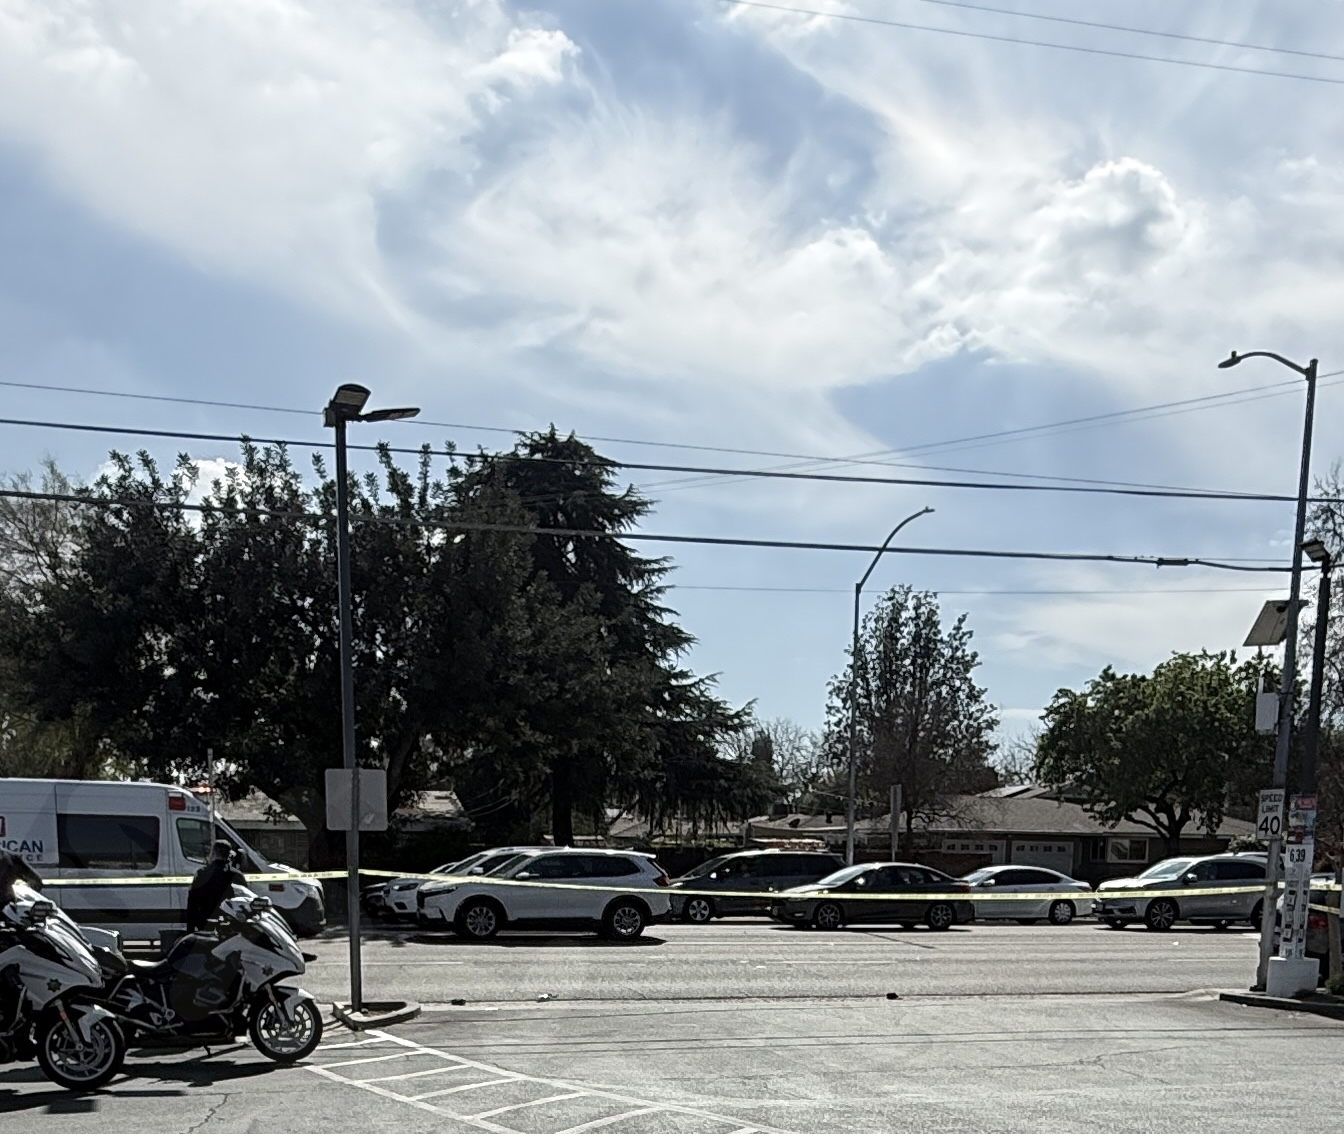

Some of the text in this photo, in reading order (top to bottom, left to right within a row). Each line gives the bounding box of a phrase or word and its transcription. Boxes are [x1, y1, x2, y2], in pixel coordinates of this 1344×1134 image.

[1261, 794, 1283, 802] SPEED
[1262, 805, 1279, 813] LIMIT
[1259, 816, 1281, 835] 40
